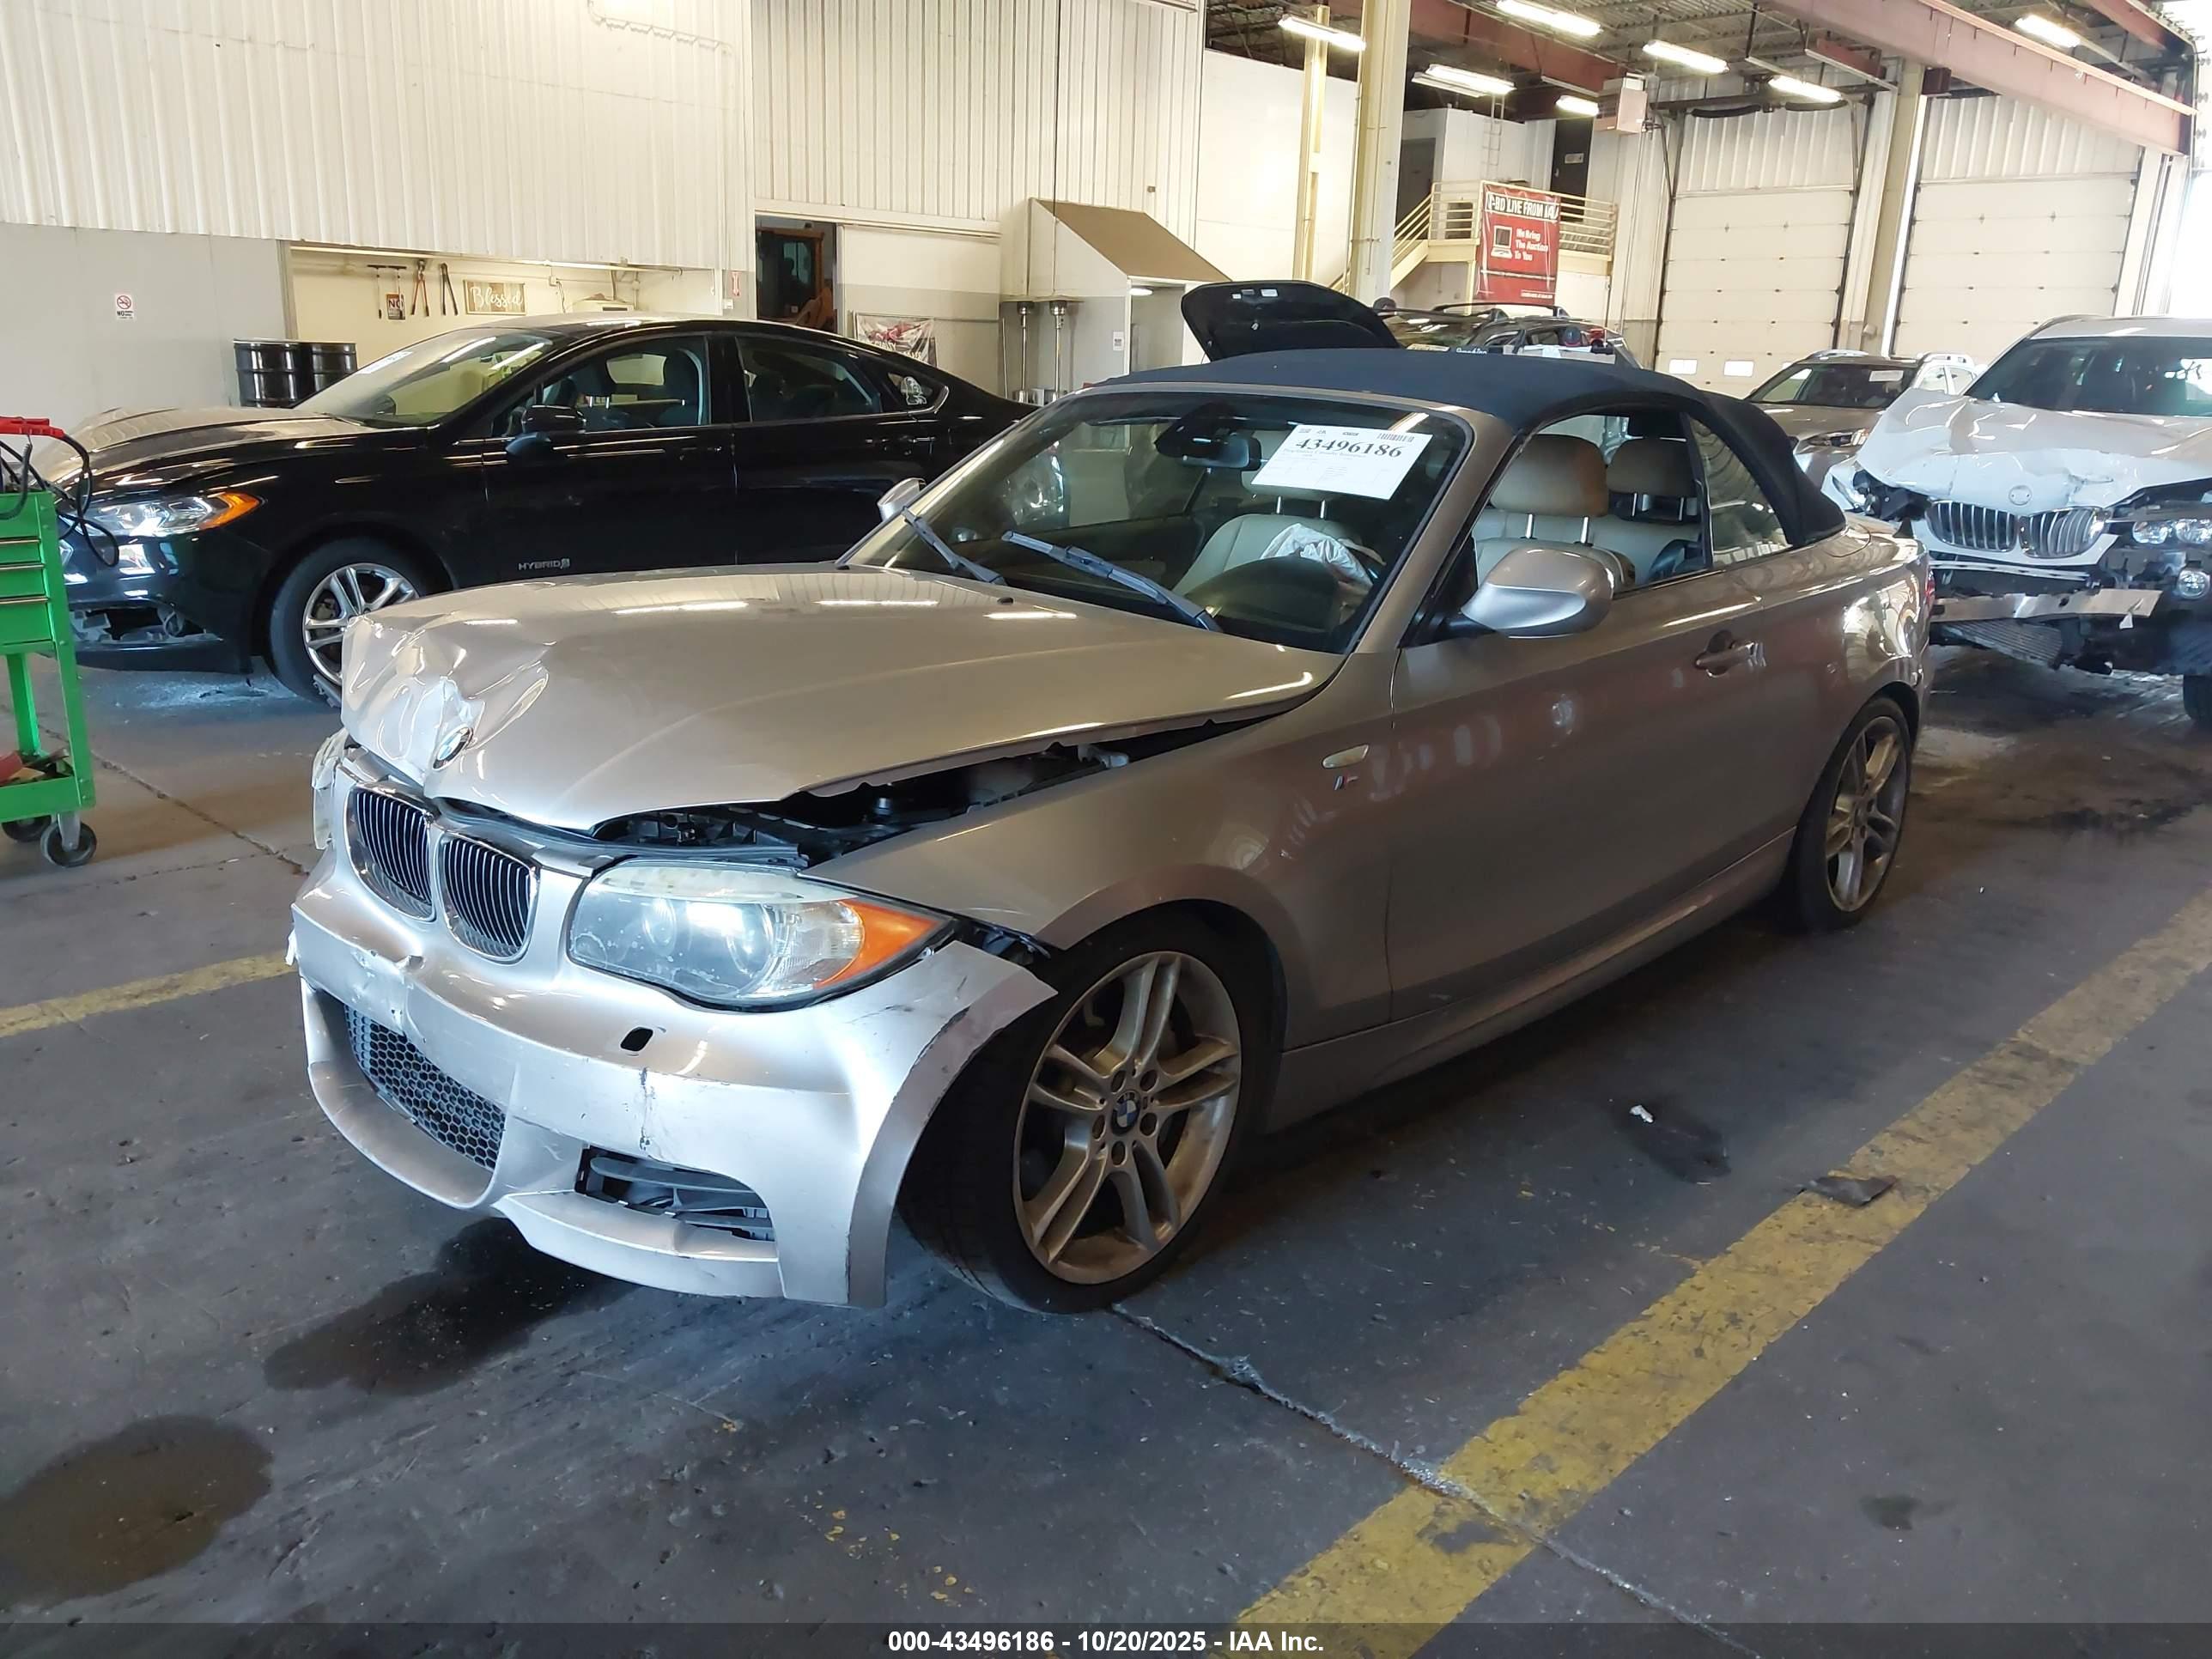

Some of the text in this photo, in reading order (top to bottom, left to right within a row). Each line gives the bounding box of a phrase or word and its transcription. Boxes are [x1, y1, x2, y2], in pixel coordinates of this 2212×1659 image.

[1506, 198, 1522, 214] LIVE
[1523, 201, 1544, 217] FROM
[1515, 239, 1526, 249] The
[1296, 438, 1403, 459] 43496186
[518, 560, 561, 571] HYBRID
